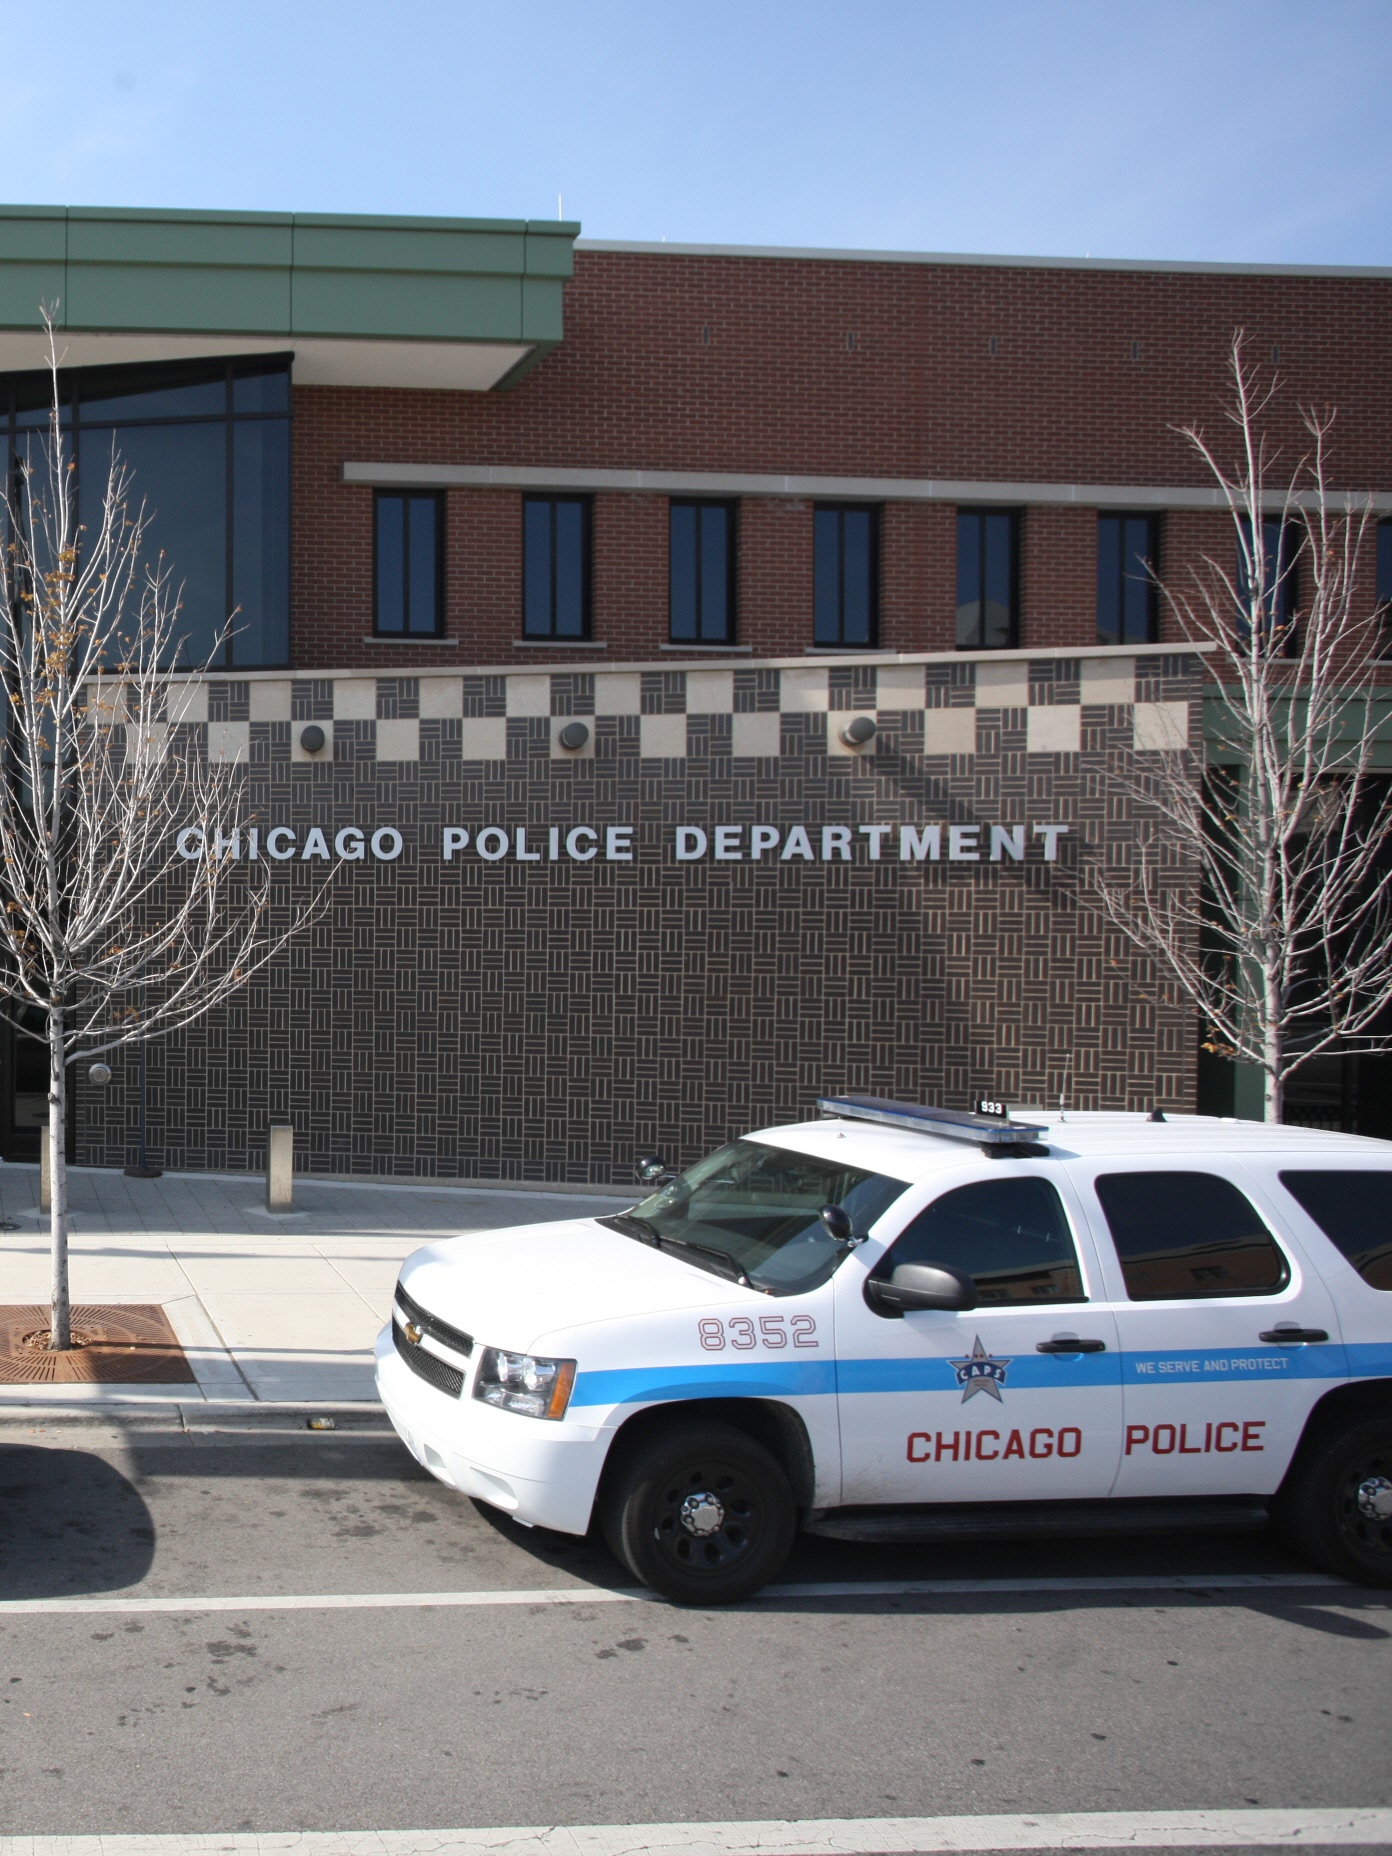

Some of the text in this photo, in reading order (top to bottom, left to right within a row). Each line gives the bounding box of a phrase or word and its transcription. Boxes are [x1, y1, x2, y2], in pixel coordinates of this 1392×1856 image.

[176, 824, 1070, 862] CHICAGO POLICE DEPARTMENT
[980, 1101, 1003, 1115] 933
[697, 1314, 819, 1351] 8352
[960, 1365, 1002, 1380] CAPS
[1135, 1357, 1289, 1374] WE SERVE AND PROTECT
[906, 1421, 1266, 1463] CHICAGO POLICE
